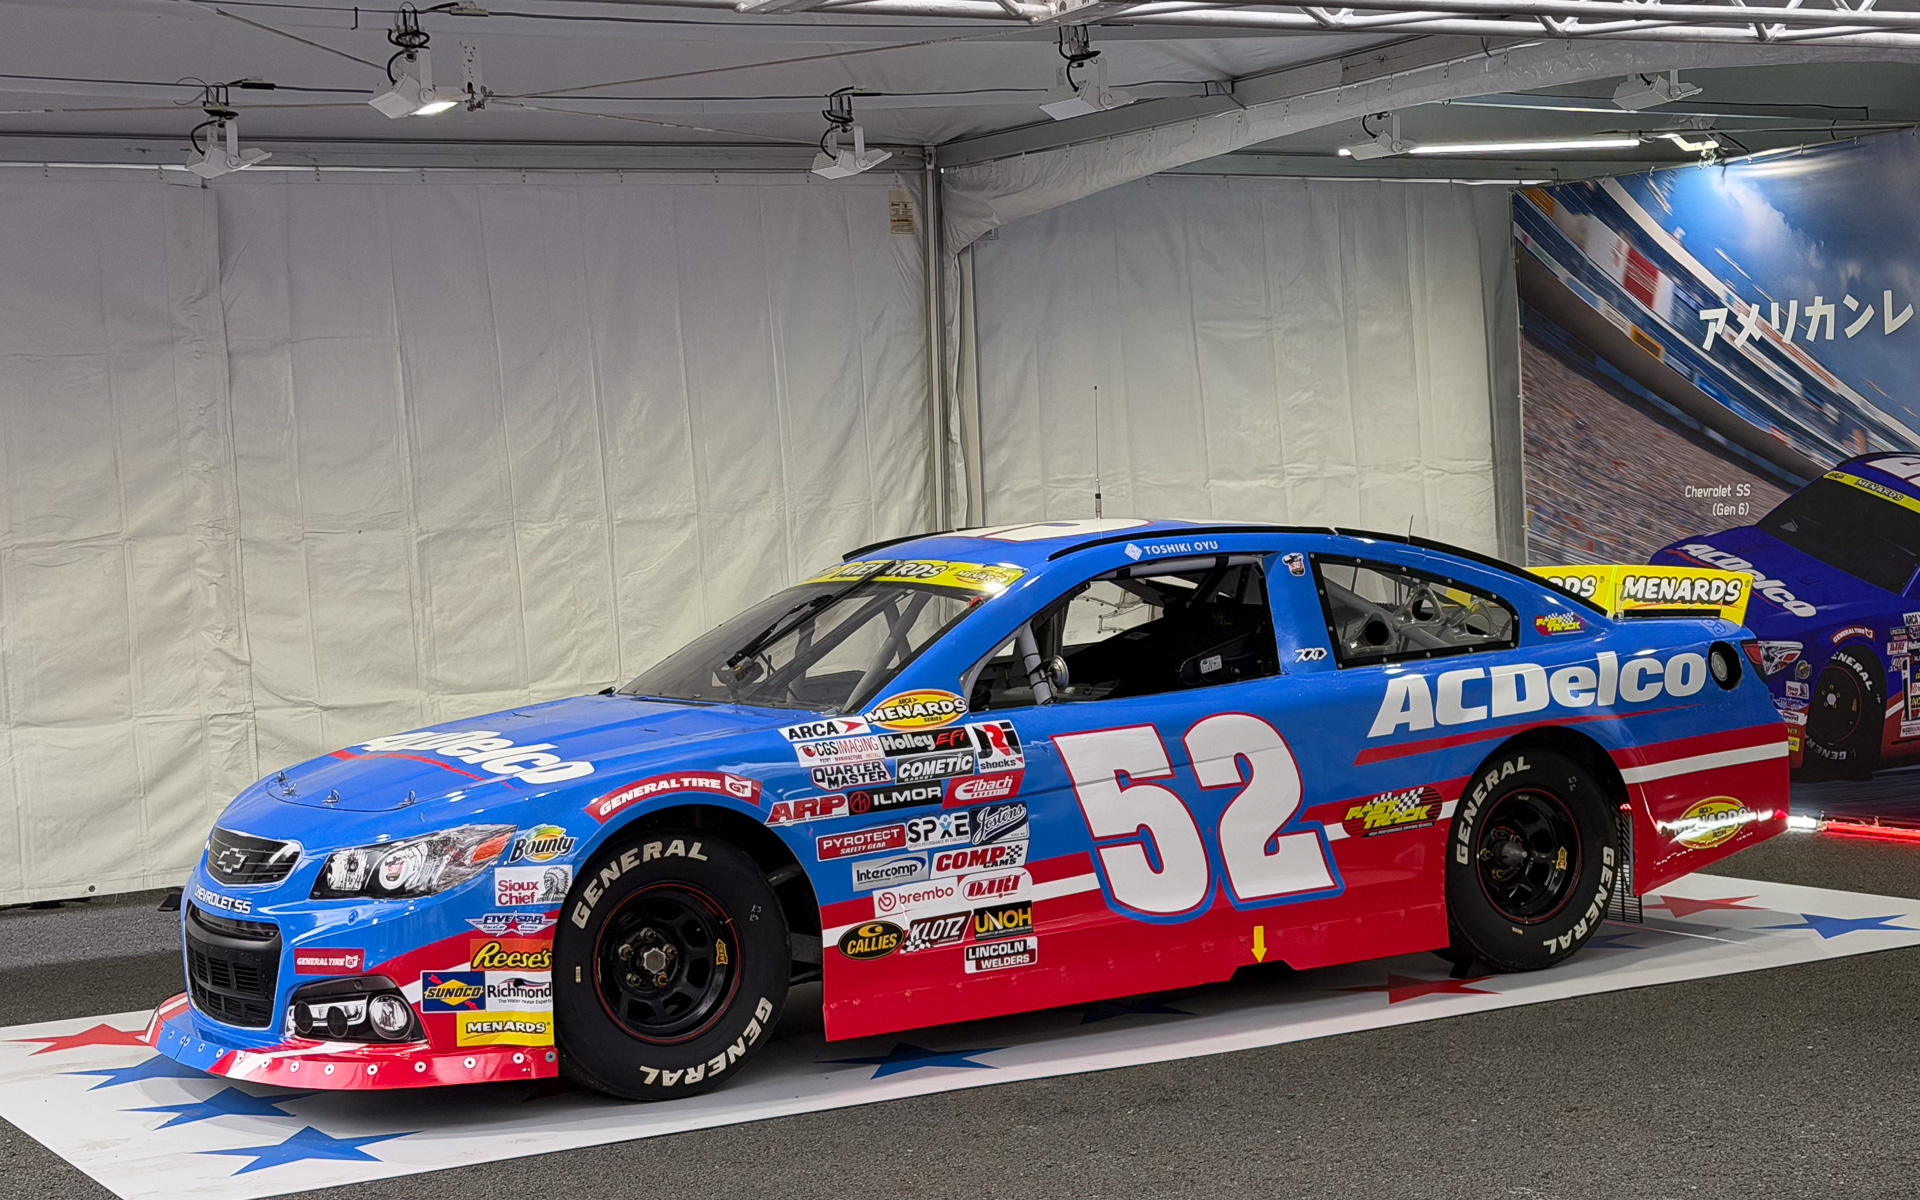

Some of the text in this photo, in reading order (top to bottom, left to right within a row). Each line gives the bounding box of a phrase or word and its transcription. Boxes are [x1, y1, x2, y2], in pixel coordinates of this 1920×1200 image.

[1699, 289, 1914, 351] アメリカンレ
[1685, 484, 1751, 498] Chevrolet SS
[1855, 479, 1905, 501] MENARDS
[1712, 502, 1749, 516] (Gen 6)
[1143, 541, 1219, 554] TOSHIKI OYU
[1547, 575, 1597, 598] DS
[1621, 575, 1743, 604] MENARDS
[1367, 650, 1707, 738] ACDelco
[864, 698, 968, 723] MENARDS
[788, 721, 840, 741] ARCA
[882, 729, 965, 751] Holley EFI
[812, 761, 882, 782] QUARTER
[899, 755, 974, 779] COMETIC
[980, 759, 1017, 770] shocks
[828, 770, 888, 788] MASTER
[954, 776, 1013, 800] Eibach
[600, 778, 680, 816] GENERAL
[681, 777, 721, 789] TIRE
[873, 786, 942, 806] ILMOR
[767, 795, 846, 823] ARP
[1050, 711, 1338, 914] 52
[1345, 799, 1399, 821] FAST
[1364, 804, 1433, 829] TRACK
[1456, 755, 1531, 865] GENERAL
[972, 804, 1027, 845] Jostens
[509, 836, 574, 863] Bounty
[823, 828, 900, 849] PYROTECT
[840, 841, 886, 855] SAFETY GEAR
[936, 846, 1006, 872] COMP
[983, 857, 1017, 868] CAMS
[856, 863, 918, 882] Intercomp
[498, 880, 539, 892] Sioux
[571, 839, 708, 929] GENERAL
[967, 873, 1024, 897] DART
[194, 883, 252, 914] CHEVROLET SS
[498, 892, 537, 905] Chief
[899, 886, 954, 905] brembo
[1543, 846, 1615, 954] GENERAL
[484, 915, 544, 924] FIVE STAR
[911, 916, 966, 941] KLOTZ
[975, 907, 1032, 933] UNOH
[471, 941, 552, 969] Reese's
[847, 933, 898, 955] CALLIES
[969, 941, 1025, 959] LINCOLN
[297, 957, 328, 966] GENERAL
[328, 957, 345, 966] TIRE
[981, 954, 1030, 969] WELDERS
[426, 986, 483, 999] SUNOCO
[487, 982, 552, 998] Richmond
[467, 1020, 546, 1033] MENARDS
[639, 997, 773, 1086] GENERAL
